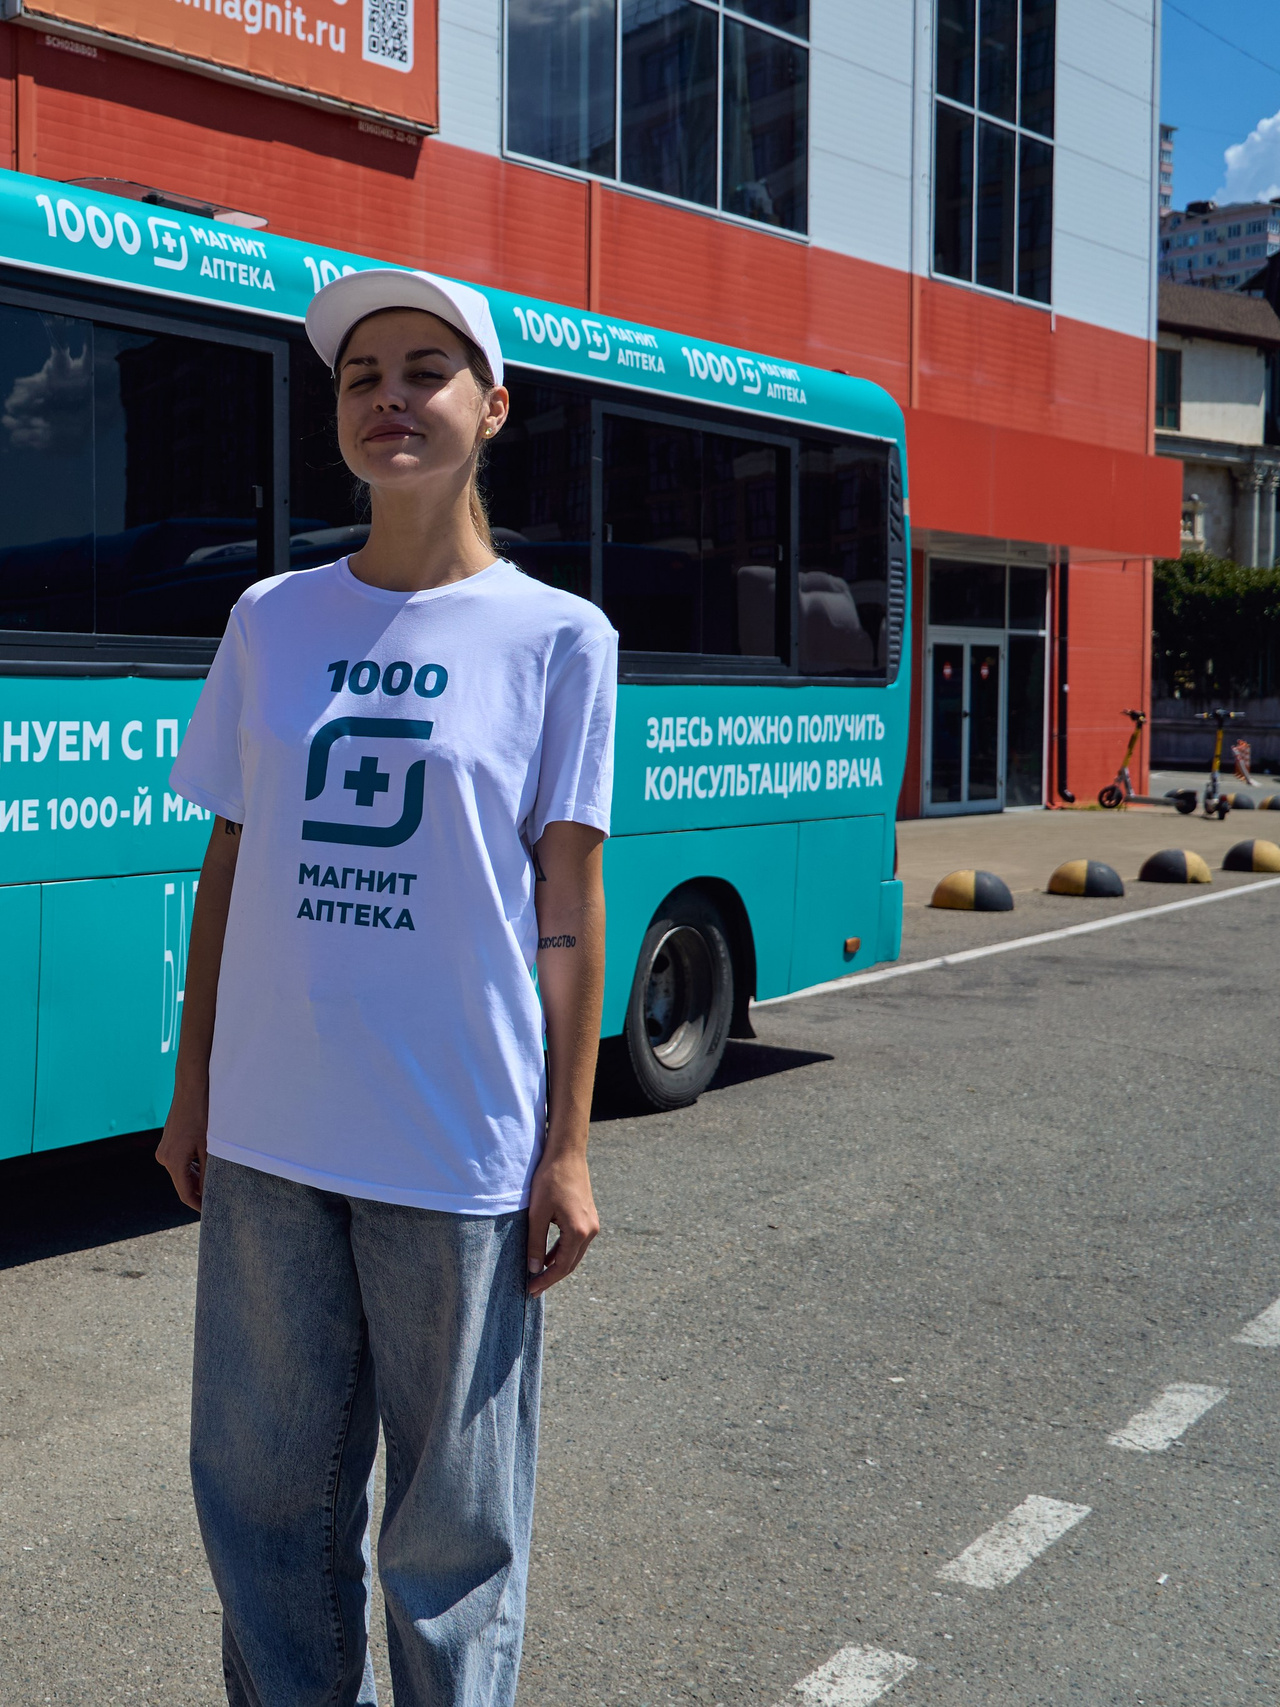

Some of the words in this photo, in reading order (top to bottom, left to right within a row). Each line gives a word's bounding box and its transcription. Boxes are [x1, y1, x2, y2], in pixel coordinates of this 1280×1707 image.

[36, 194, 141, 255] 1000
[189, 225, 267, 259] МАГНИТ
[200, 256, 276, 291] АПТЕКА
[513, 306, 580, 351] 1000
[607, 325, 658, 349] МАГНИТ
[617, 348, 665, 374] АПТЕКА
[681, 347, 737, 386] 1000
[757, 361, 801, 382] МАГНИТ
[767, 382, 807, 405] АПТЕКА
[327, 660, 448, 698] 1000
[121, 720, 142, 761] С
[156, 718, 194, 759] П
[646, 716, 713, 753] ЗДЕСЬ
[718, 716, 793, 746] МОЖНО
[797, 714, 885, 743] ПОЛУЧИТЬ
[644, 760, 821, 800] КОНСУЛЬТАЦИЮ
[826, 757, 883, 790] ВРАЧА
[47, 787, 151, 830] 1000-Й
[298, 863, 417, 895] МАГНИТ
[297, 898, 415, 931] АПТЕКА
[161, 880, 199, 1053] БА
